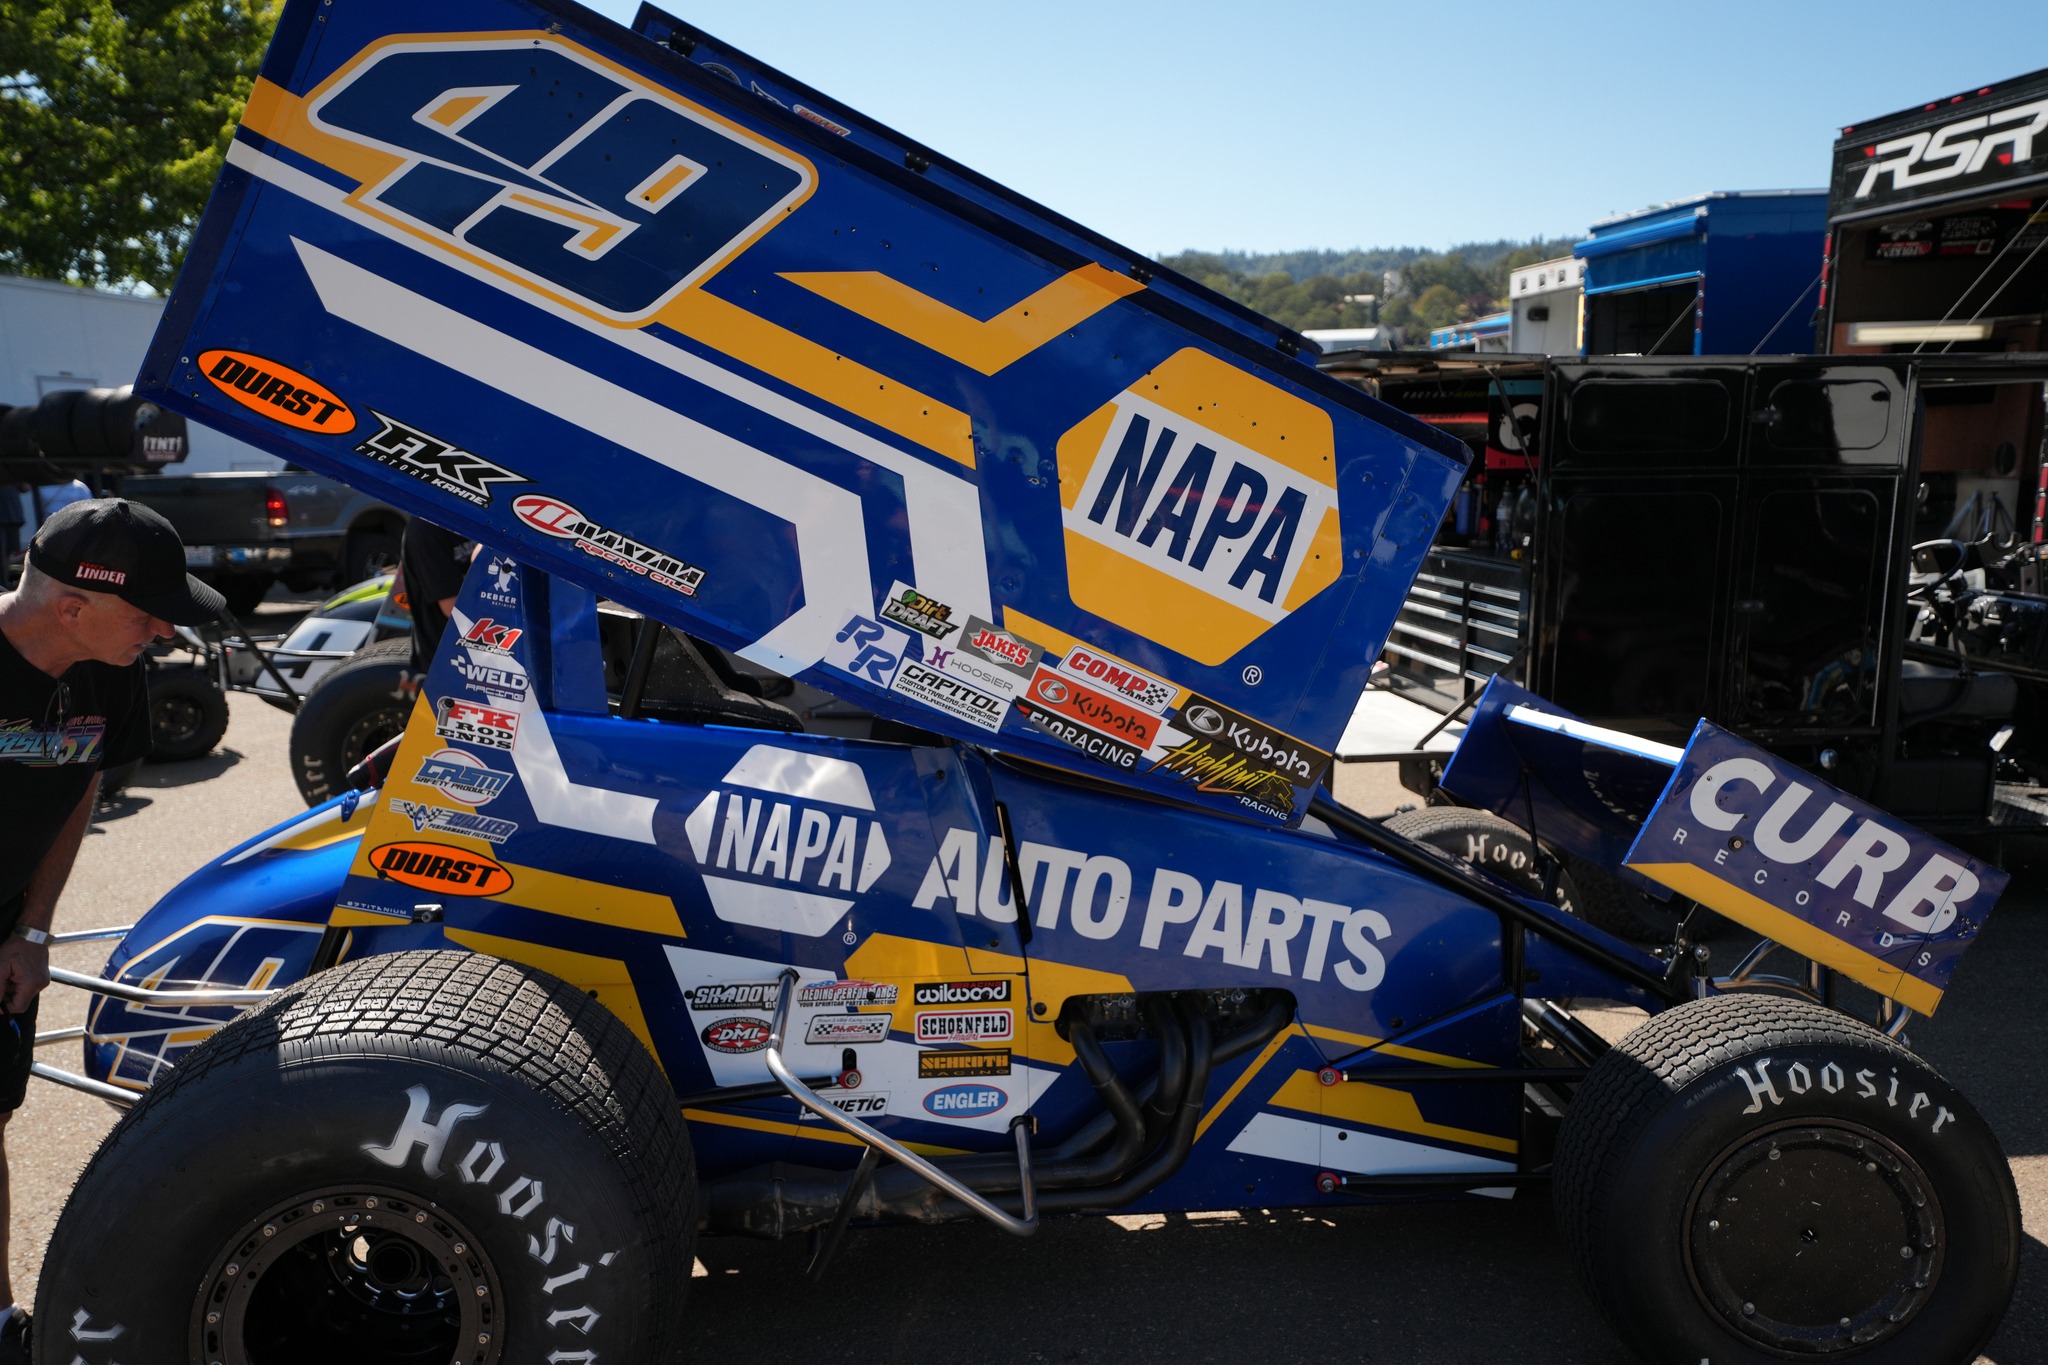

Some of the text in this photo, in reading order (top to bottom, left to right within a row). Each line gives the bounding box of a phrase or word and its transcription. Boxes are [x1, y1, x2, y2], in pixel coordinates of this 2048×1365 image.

[1855, 100, 2048, 198] RSR
[308, 38, 812, 322] 49
[208, 356, 346, 425] DURST
[366, 409, 529, 497] FK
[356, 445, 488, 506] FACTORY KAHNE
[1088, 413, 1307, 604] NAPA
[567, 520, 704, 586] MAXIMA
[75, 566, 127, 585] LINDER
[575, 540, 696, 596] RACING OILS
[480, 591, 517, 604] DEBEER
[909, 595, 947, 619] Dirt
[888, 601, 952, 636] DRAFT
[455, 638, 515, 657] RaceGear
[465, 618, 523, 650] K1
[972, 630, 1031, 667] JAKE'S
[996, 652, 1014, 662] CARTS
[466, 664, 529, 690] WELD
[951, 659, 1013, 692] HOOSIER
[1068, 652, 1148, 692] COMP
[466, 683, 525, 702] RACING
[899, 676, 927, 693] CUSTOM
[927, 689, 959, 706] TRAILERS
[966, 705, 999, 722] COACHES
[902, 664, 1001, 717] CAPITOL
[1117, 686, 1156, 706] CAMS
[448, 704, 515, 731] FK
[896, 683, 996, 730] CAPITOLRENEGADE.COM
[1073, 692, 1146, 740] Kubota
[436, 728, 511, 749] ENDS
[456, 721, 513, 739] ROD
[56, 724, 105, 766] 57
[1227, 722, 1311, 778] Kubota
[414, 776, 498, 797] SAFETY PRODUCTS
[1240, 796, 1288, 821] RACING
[428, 823, 506, 843] PERFORMANCE FILTRATION
[447, 813, 518, 837] WALKER
[716, 793, 858, 891] NAPA
[1690, 757, 1980, 933] CURB
[380, 848, 501, 887] DURST
[912, 826, 1392, 992] AUTO PARTS
[1672, 827, 1931, 966] RECORDS
[695, 985, 779, 1004] SHADOW
[798, 988, 835, 1001] KAEDING
[916, 981, 1007, 1003] wilwood
[708, 1018, 735, 1031] DIVERSIFIED
[718, 1027, 760, 1041] DMI
[831, 1025, 865, 1033] BMRS
[922, 1016, 1007, 1035] SCHOENFELD
[708, 1042, 735, 1053] DIVERSIFIED
[921, 1055, 1008, 1069] SCHROTH
[804, 1097, 886, 1113] METIC
[933, 1091, 999, 1110] ENGLER
[1733, 1058, 1955, 1134] Hoosier
